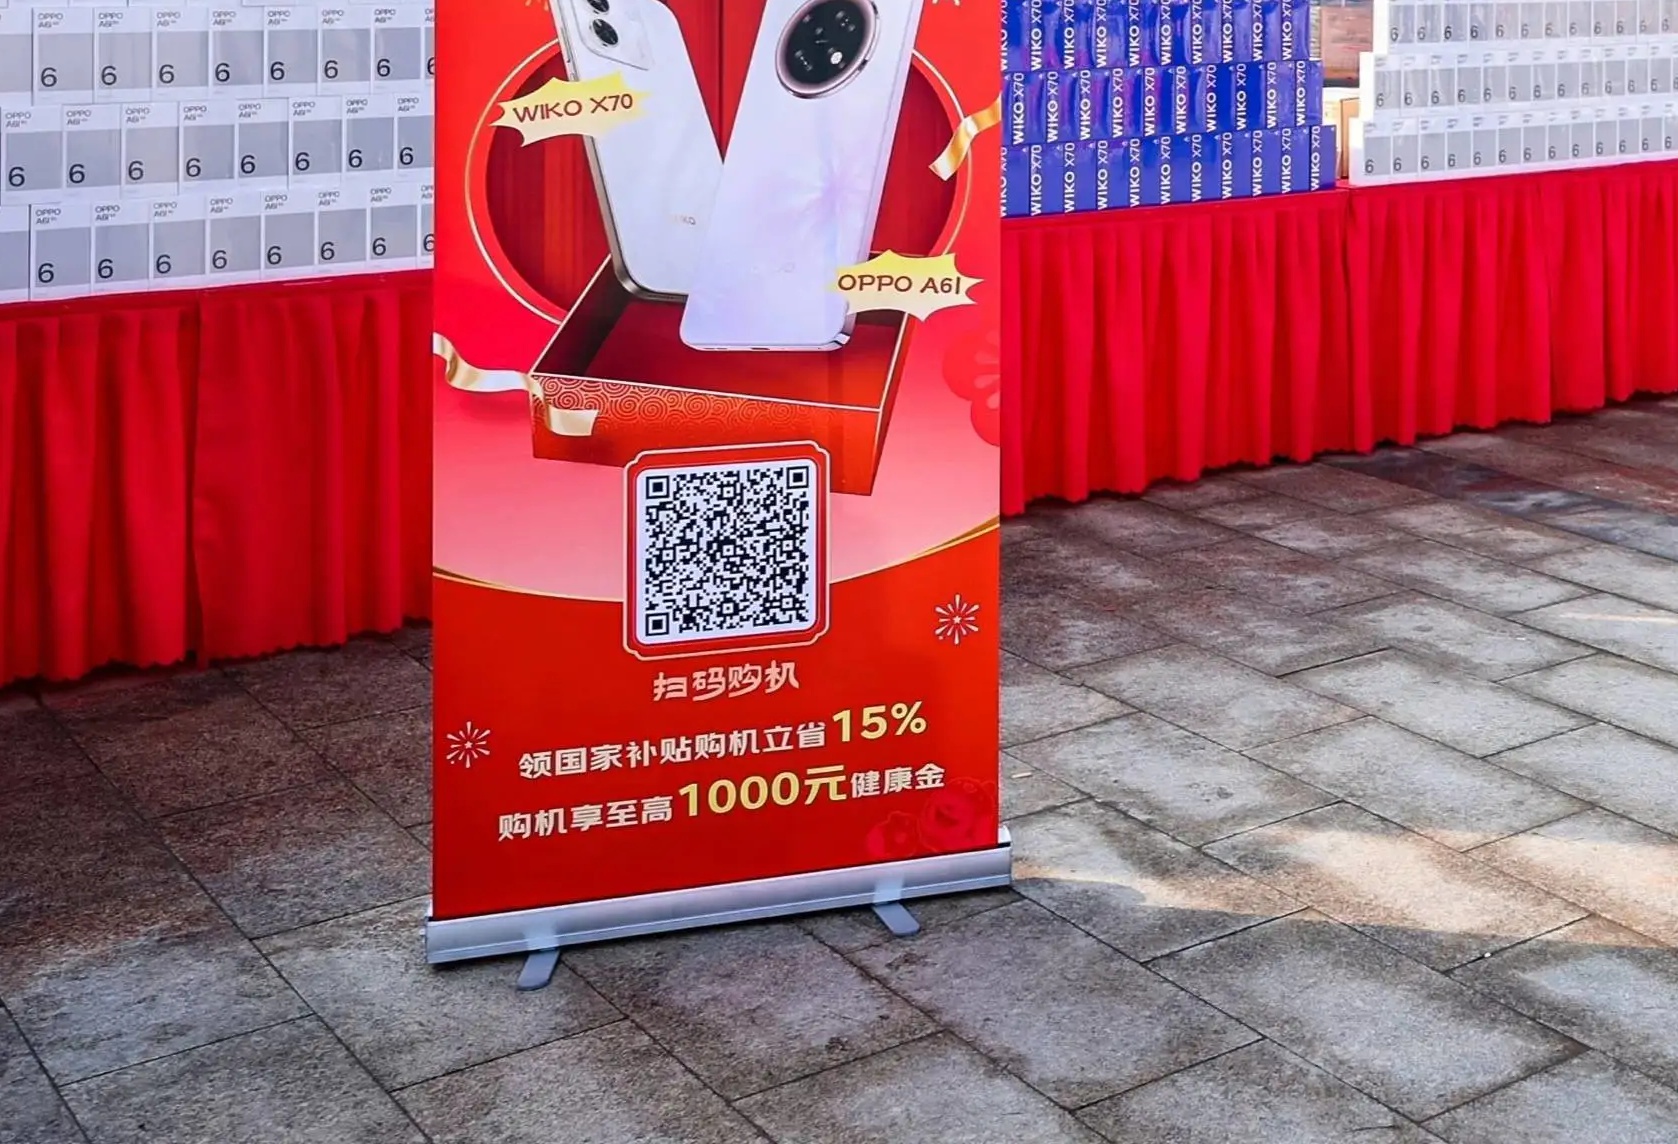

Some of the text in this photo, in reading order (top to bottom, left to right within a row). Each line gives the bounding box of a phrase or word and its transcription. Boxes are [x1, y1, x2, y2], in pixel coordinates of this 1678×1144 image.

[66, 109, 91, 118] OPPO
[126, 107, 150, 116] OPPO
[184, 105, 208, 114] OPPO
[239, 102, 262, 111] OPPO
[292, 101, 315, 109] OPPO
[513, 93, 634, 123] WIKO X70
[5, 111, 31, 120] OPPO
[241, 155, 255, 174] 6
[295, 152, 310, 171] 6
[348, 149, 362, 168] 6
[400, 147, 413, 165] 6
[9, 167, 25, 187] 6
[69, 164, 85, 184] 6
[128, 161, 143, 180] 6
[186, 158, 201, 177] 6
[36, 208, 62, 217] OPPO
[95, 205, 120, 214] OPPO
[838, 274, 913, 292] OPPO
[653, 659, 800, 702] 扫码购机
[519, 700, 928, 781] 领国家补贴购机立省15%
[497, 763, 946, 842] 购机享至高1000元健康金
